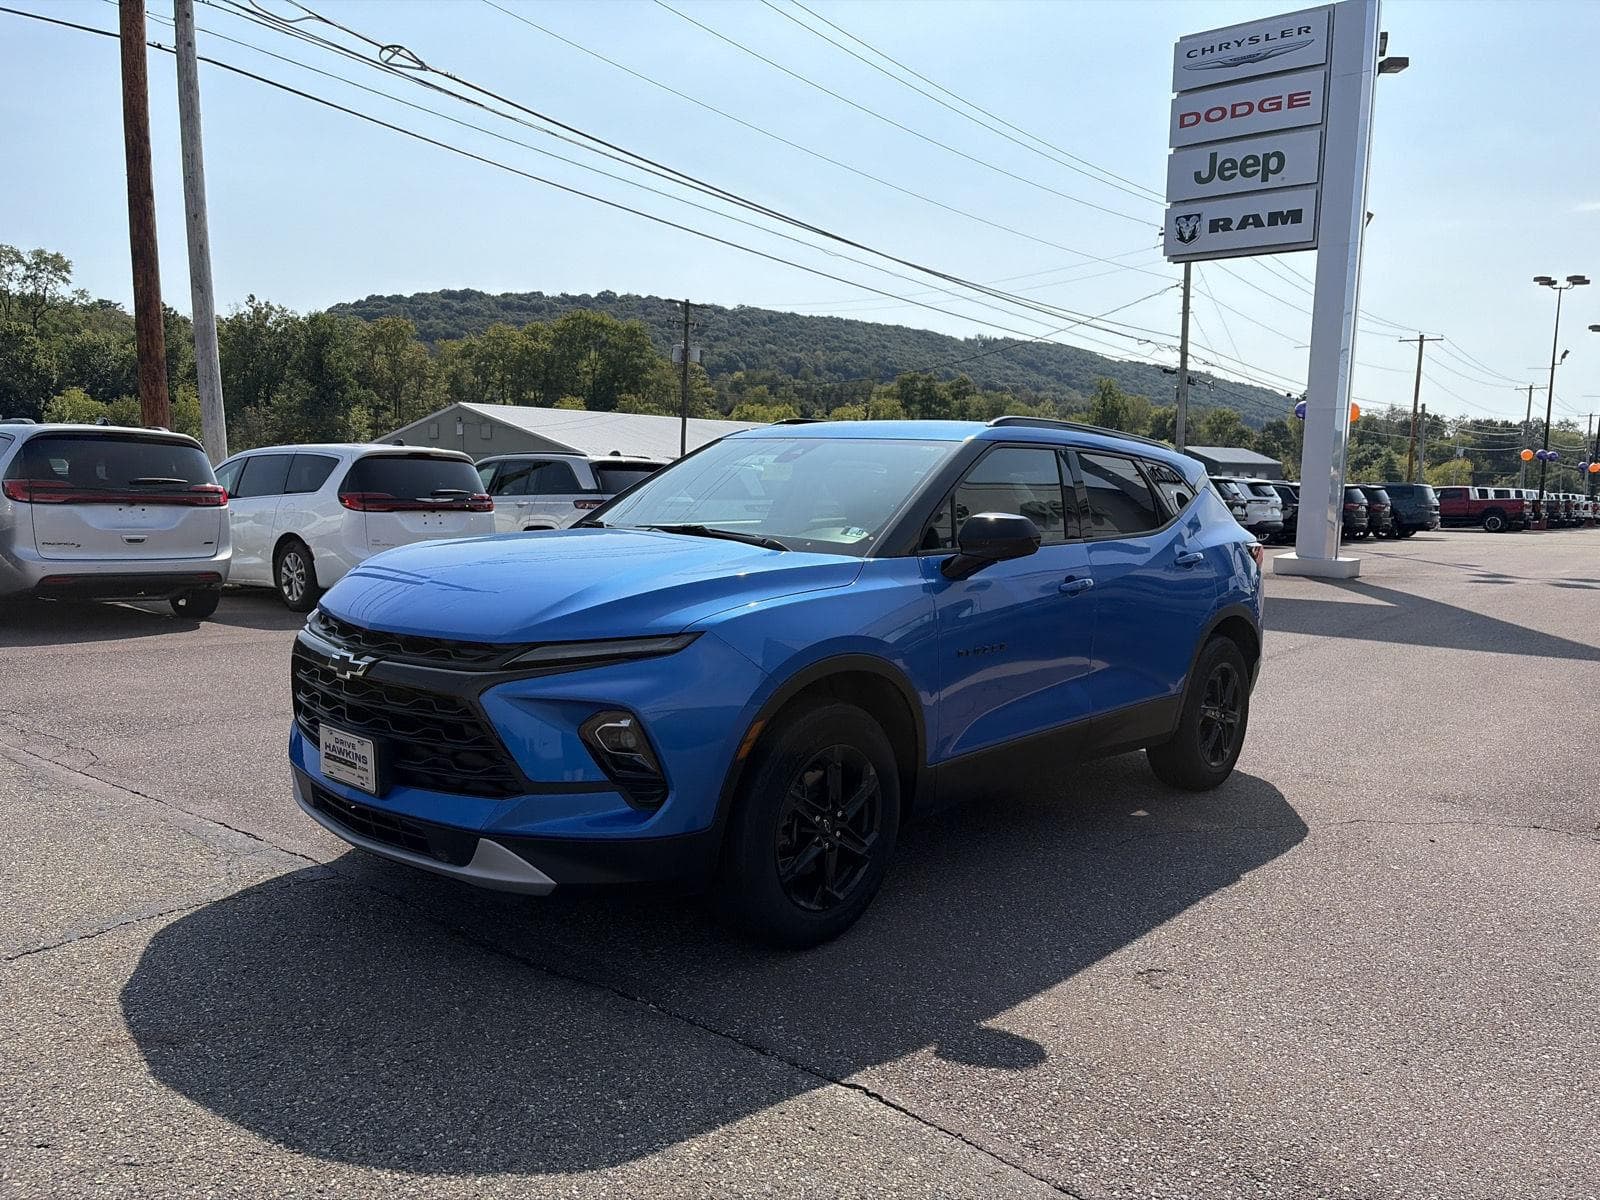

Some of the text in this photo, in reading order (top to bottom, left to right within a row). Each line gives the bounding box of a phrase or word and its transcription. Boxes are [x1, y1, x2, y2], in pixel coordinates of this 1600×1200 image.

[1186, 25, 1312, 59] CHRYSLER
[1179, 91, 1312, 128] DODGE
[1194, 150, 1286, 185] Jeep
[1208, 208, 1303, 234] RAM
[324, 742, 368, 764] HAWKINS
[335, 737, 357, 750] DRIVE
